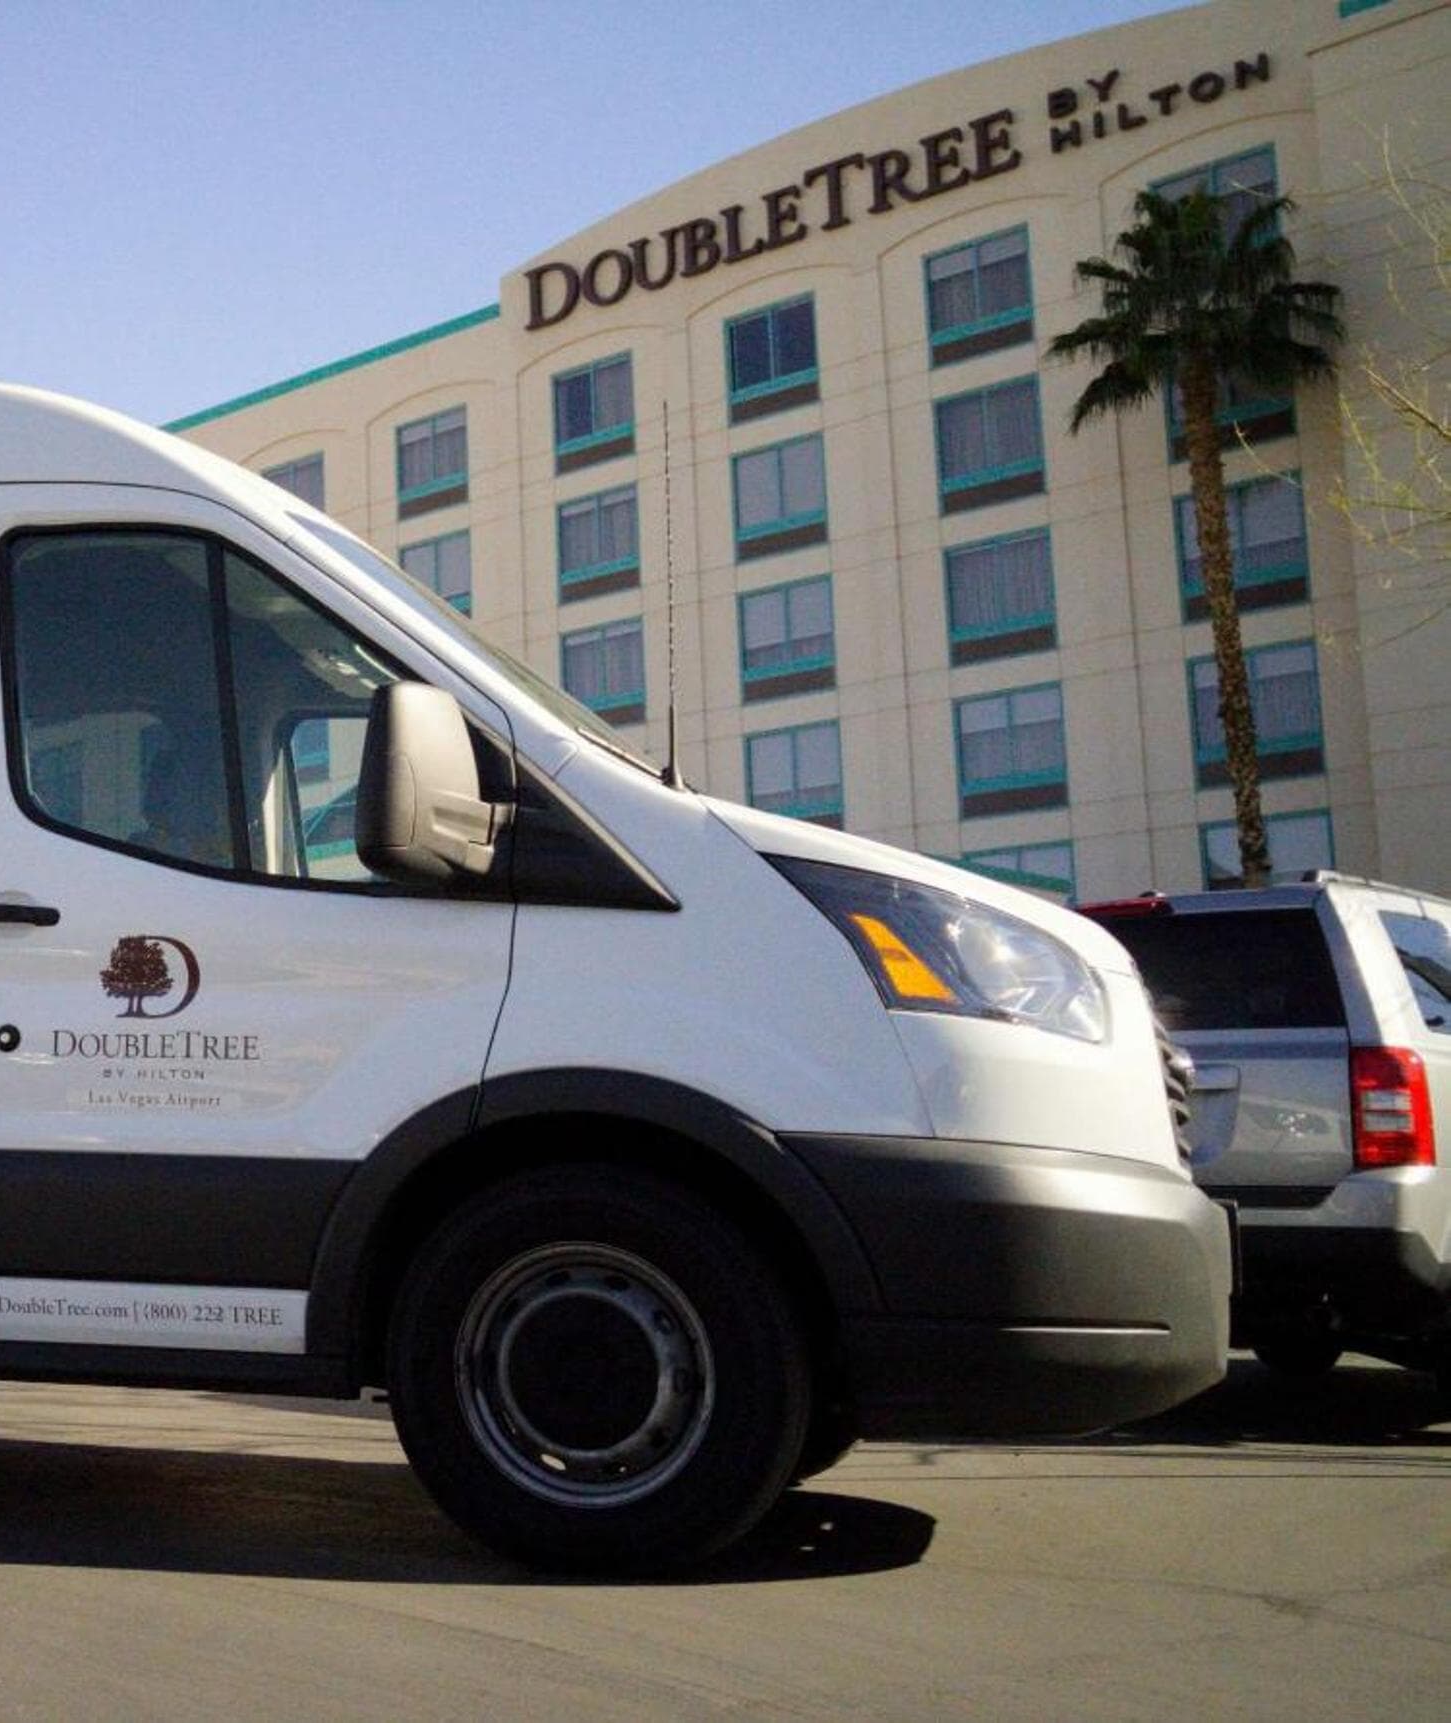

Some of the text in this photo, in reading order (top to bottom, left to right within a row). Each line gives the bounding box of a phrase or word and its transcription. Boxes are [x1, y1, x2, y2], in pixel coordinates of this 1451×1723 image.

[1046, 69, 1122, 120] BY
[1049, 53, 1272, 154] HILTON
[102, 1069, 206, 1080] BY HILTON
[88, 1090, 114, 1104] Las
[118, 1091, 160, 1108] Vegas
[143, 1303, 188, 1323] (800)
[193, 1307, 225, 1323] 222
[229, 1306, 283, 1326] TREE
